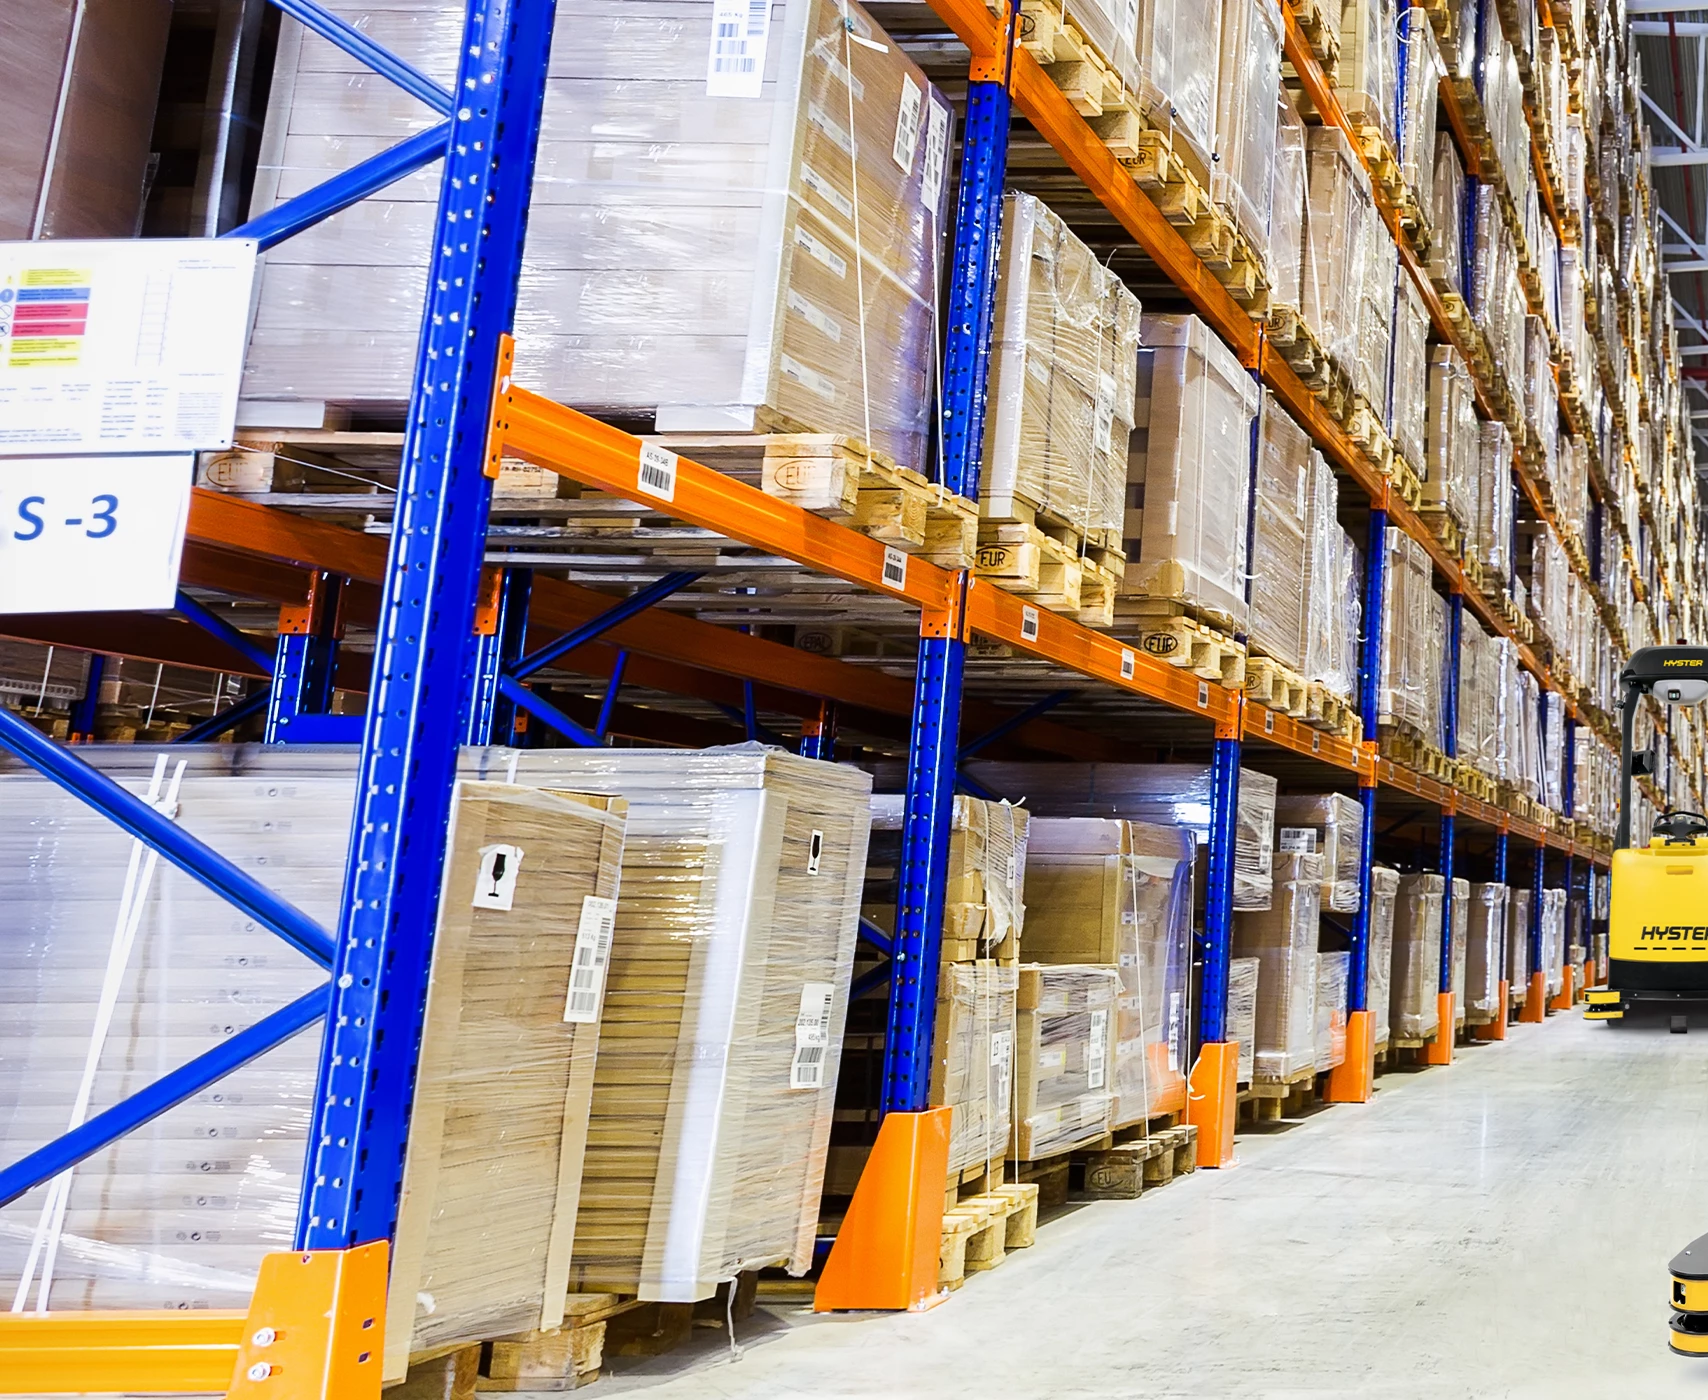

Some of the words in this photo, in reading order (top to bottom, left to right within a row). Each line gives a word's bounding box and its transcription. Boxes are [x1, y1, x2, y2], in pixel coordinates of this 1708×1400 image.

[14, 495, 46, 541] S
[65, 494, 119, 539] -3
[980, 551, 1006, 566] EUR
[1149, 637, 1173, 652] EUR
[1663, 659, 1704, 667] HYSTER
